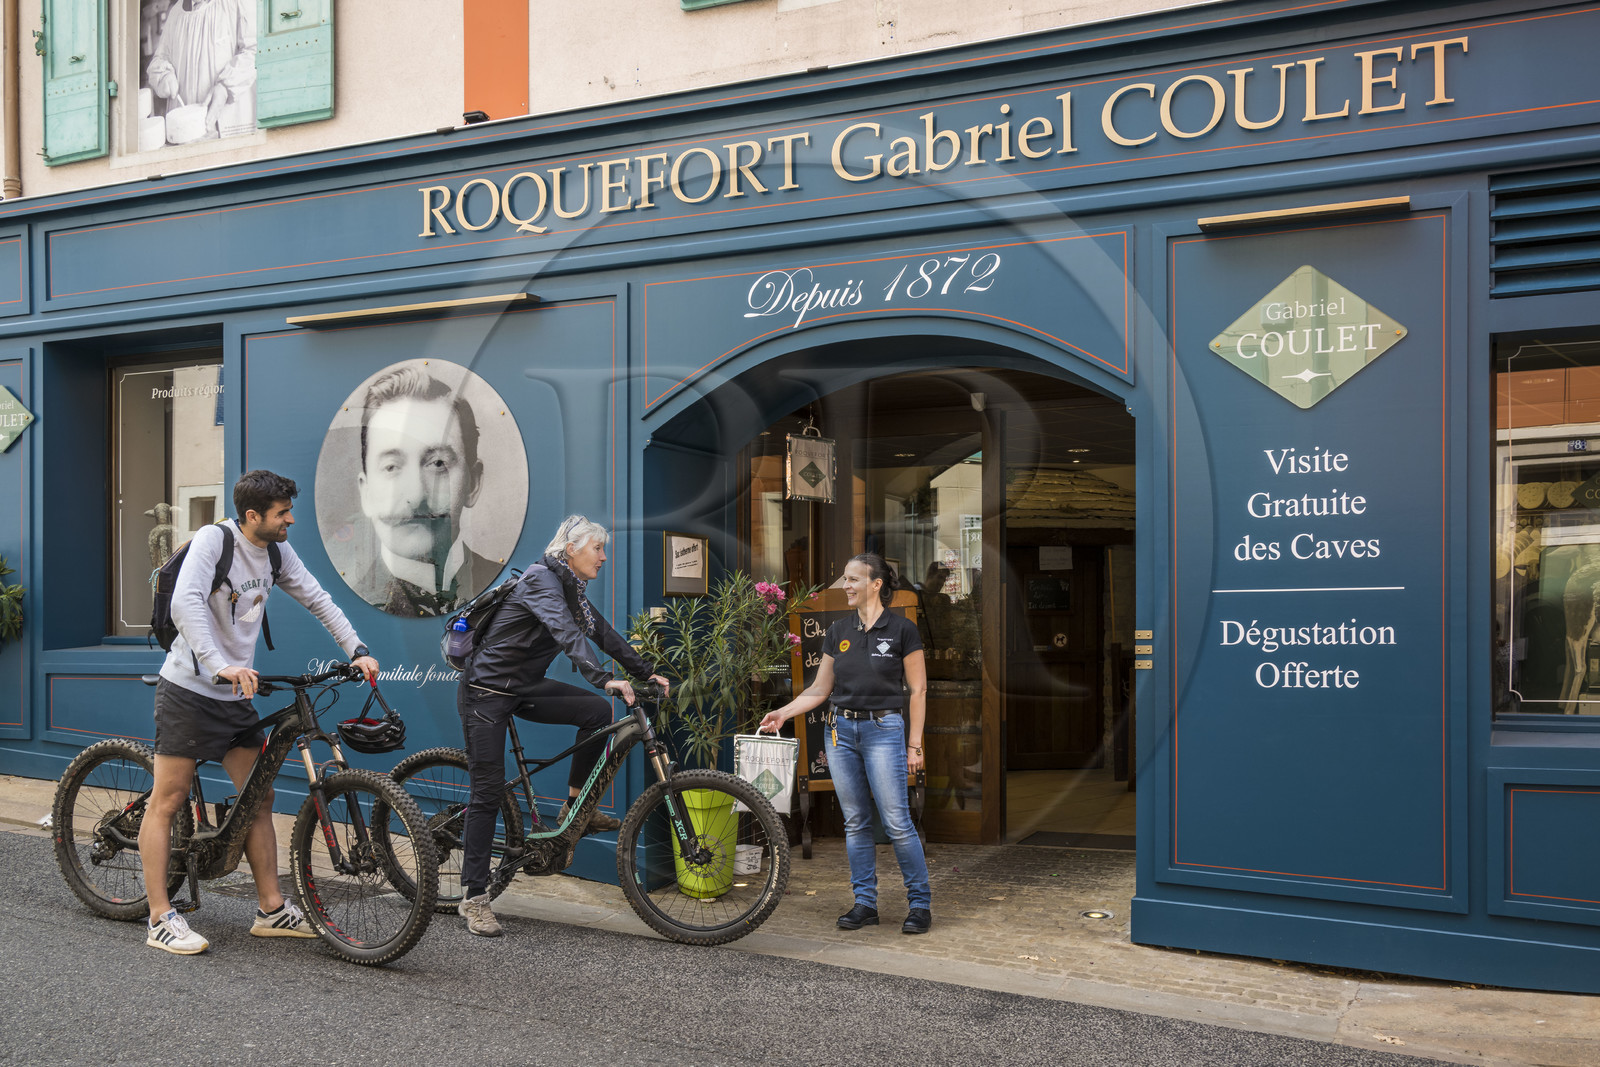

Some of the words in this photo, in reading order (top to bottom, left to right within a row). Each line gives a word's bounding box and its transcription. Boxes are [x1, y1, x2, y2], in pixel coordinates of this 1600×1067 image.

[417, 131, 809, 238] ROQUEFORT
[830, 91, 1079, 183] Gabriel
[1100, 35, 1469, 148] COULET
[743, 267, 864, 329] Depuis
[883, 252, 1001, 302] 1872
[1265, 297, 1347, 321] Gabriel
[1236, 323, 1382, 360] COULET
[0, 400, 14, 410] riel
[0, 412, 26, 428] LET
[1263, 446, 1349, 475] Visite
[1247, 488, 1367, 519] Gratuite
[1233, 534, 1281, 561] des
[1290, 533, 1381, 560] Caves
[1219, 618, 1397, 653] Dégustation
[1255, 661, 1360, 689] Offerte
[322, 824, 336, 848] XCR
[674, 819, 688, 841] XCR
